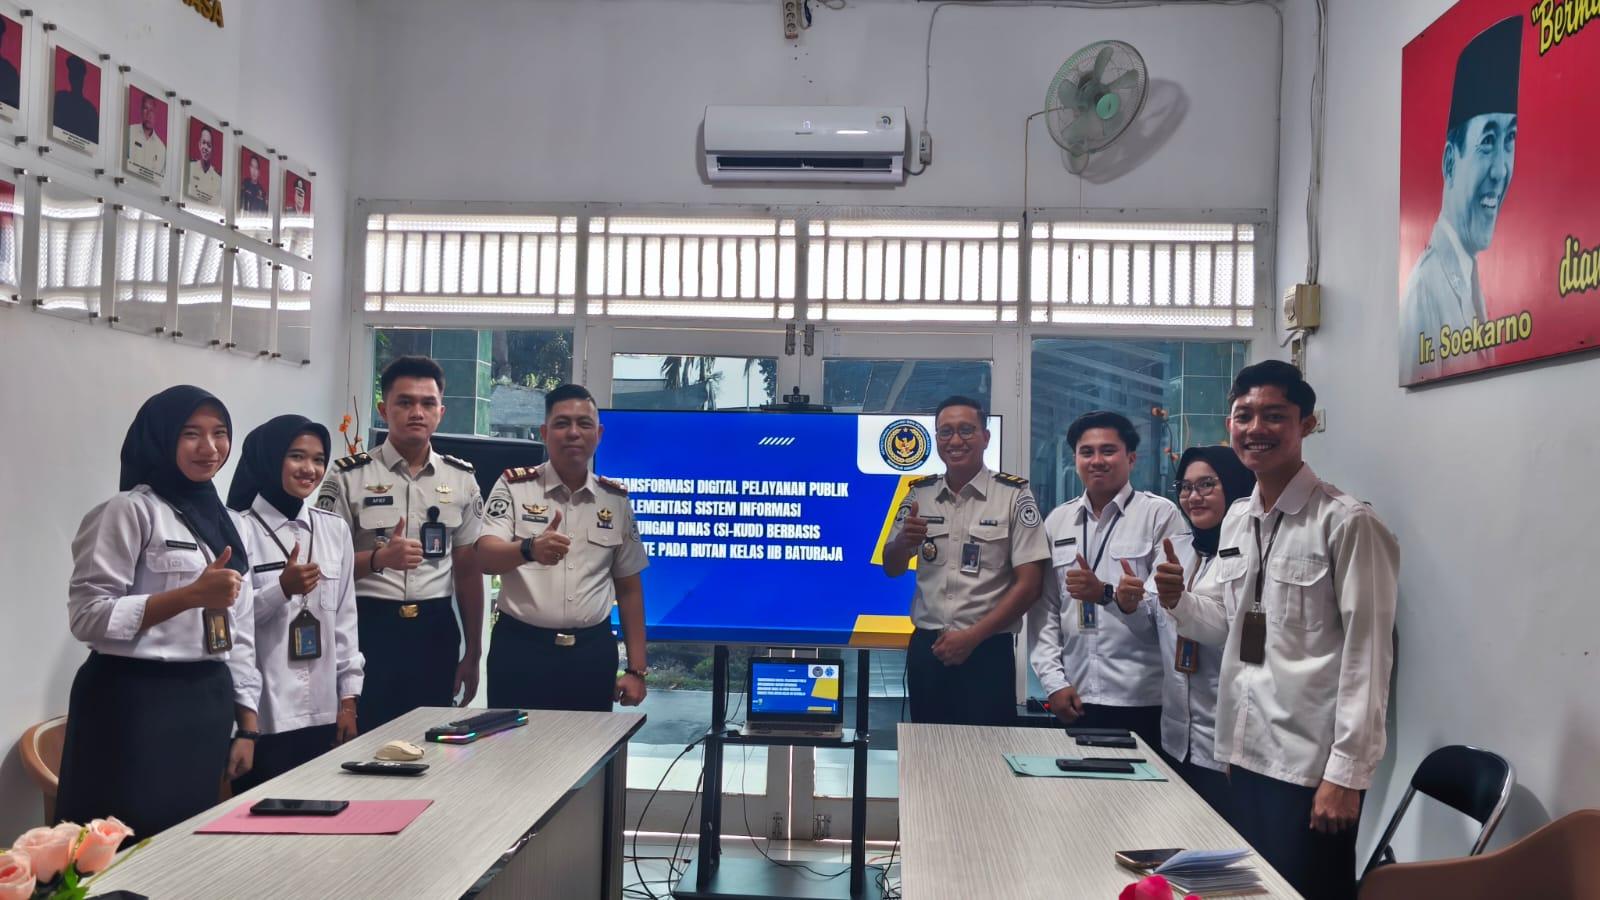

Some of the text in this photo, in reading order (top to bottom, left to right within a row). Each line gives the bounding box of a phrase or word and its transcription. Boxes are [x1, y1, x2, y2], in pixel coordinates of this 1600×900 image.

[1419, 310, 1532, 364] Ir. Soekarno
[697, 480, 739, 495] DIGITAL
[742, 480, 806, 496] PELAYANAN
[809, 482, 849, 497] PUBLIK
[630, 499, 801, 517] LEMENTASI SISTEM INFORMASI
[637, 521, 674, 536] UNGAN
[678, 522, 711, 537] DINAS
[767, 524, 821, 540] BERBASIS
[658, 542, 688, 557] PADA
[691, 543, 727, 559] RUTAN
[730, 544, 764, 560] KELAS
[767, 545, 782, 560] IIB
[785, 546, 843, 561] BATURAJA
